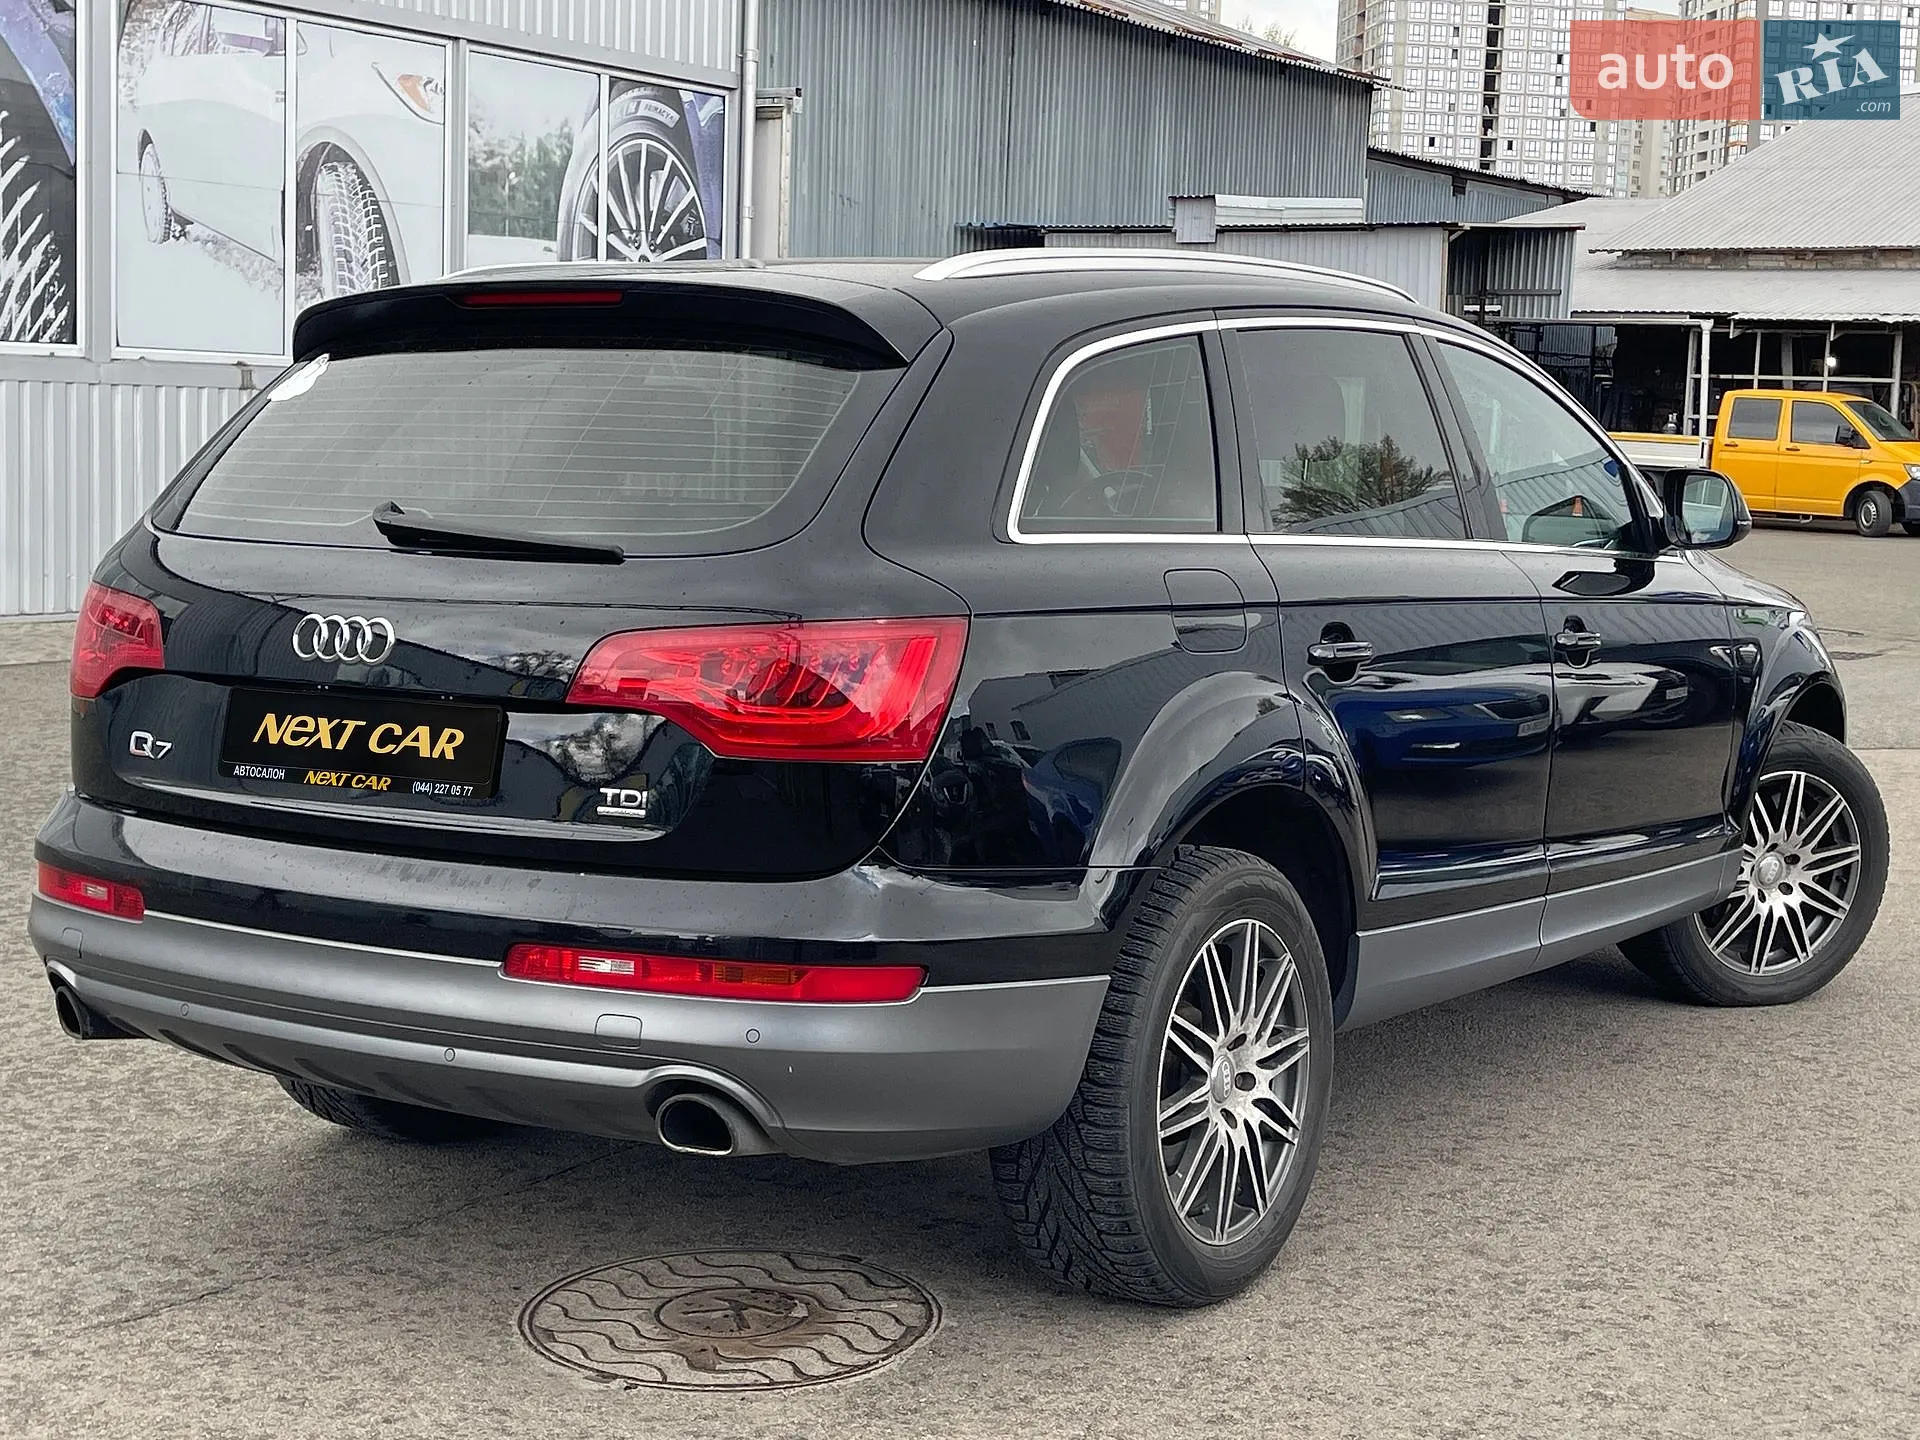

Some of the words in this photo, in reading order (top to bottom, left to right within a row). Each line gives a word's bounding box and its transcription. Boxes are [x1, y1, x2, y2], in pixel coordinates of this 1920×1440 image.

[130, 730, 172, 759] Q7
[368, 723, 464, 759] CAR
[233, 765, 285, 780] АВТОСАЛОН
[351, 774, 391, 791] CAR
[412, 781, 433, 796] (044)
[434, 783, 450, 795] 227
[450, 785, 461, 796] 05
[462, 786, 473, 797] 77
[600, 787, 648, 808] TDI
